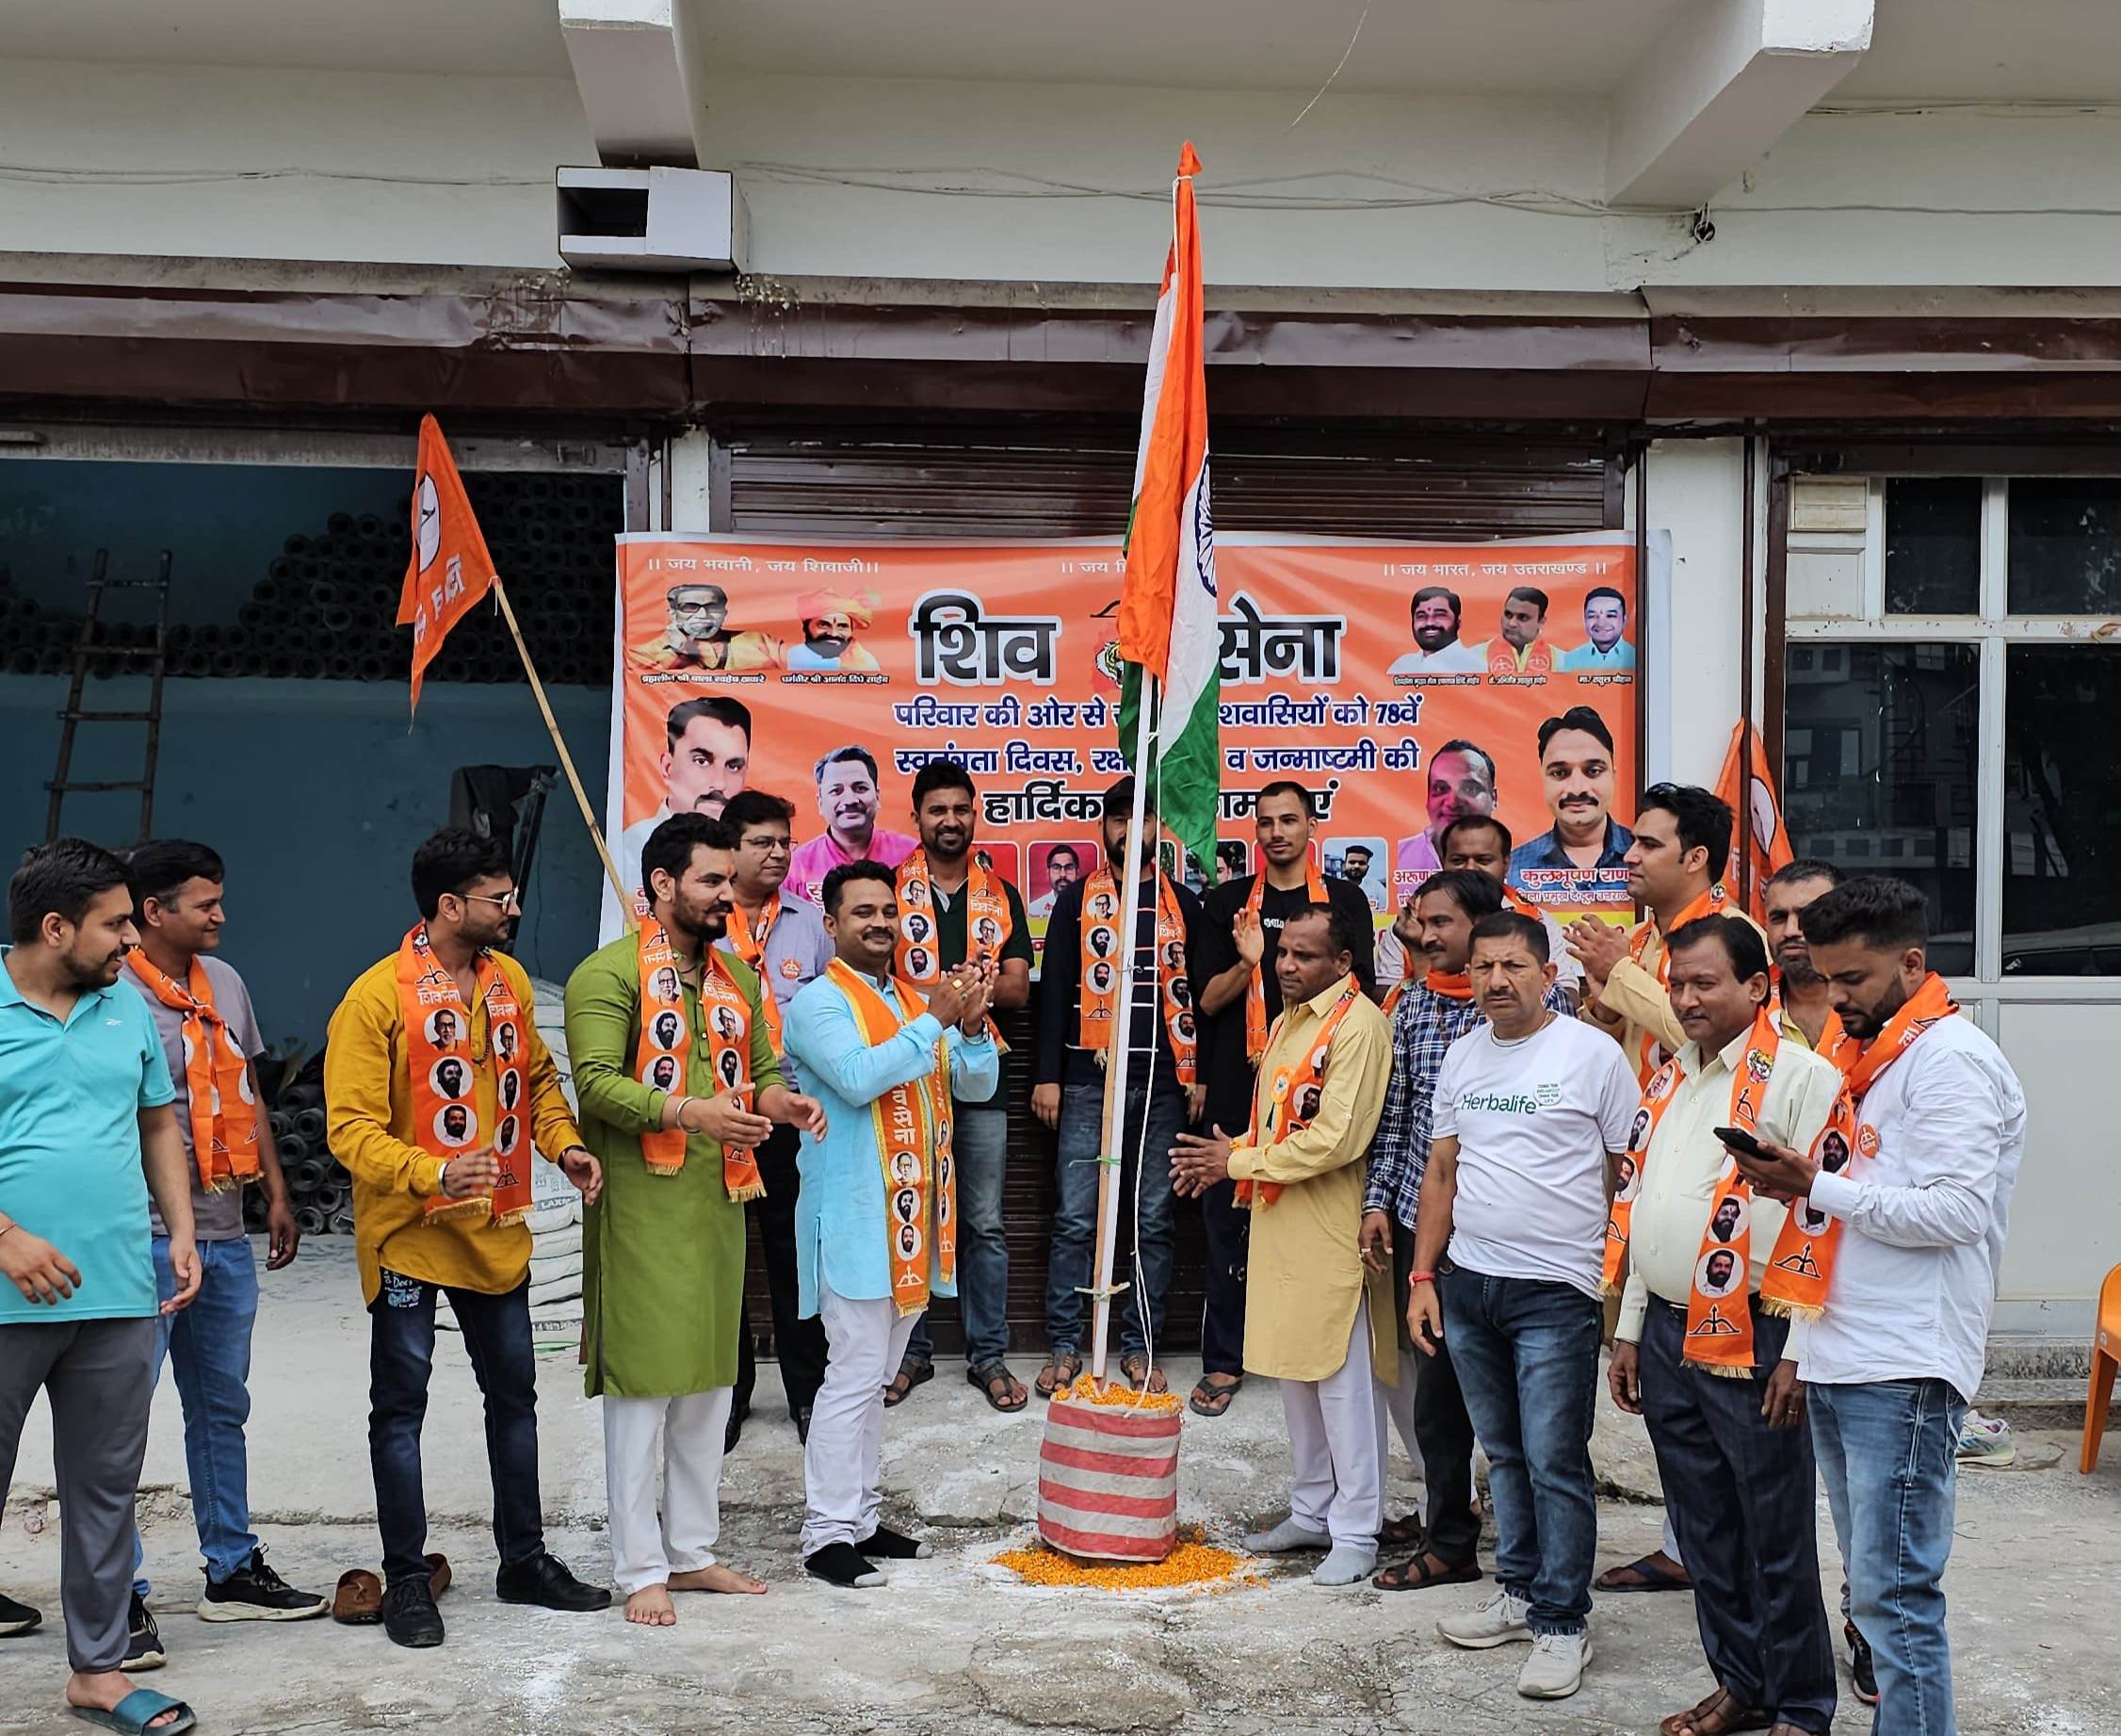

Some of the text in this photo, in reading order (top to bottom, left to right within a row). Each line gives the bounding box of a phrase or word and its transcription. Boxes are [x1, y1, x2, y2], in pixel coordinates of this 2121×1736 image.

[668, 558, 697, 570] जय
[704, 556, 759, 573] भवानी,
[768, 560, 796, 573] जय
[1080, 561, 1109, 573] जय
[1401, 563, 1427, 576] जय
[1433, 563, 1476, 577] भारत,
[1481, 563, 1507, 576] जय
[1514, 562, 1587, 576] उत्तराखण्ड
[910, 592, 1344, 682] शिव सेना
[894, 695, 978, 727] परिवार
[984, 695, 1020, 727] की
[1028, 695, 1077, 727] ओर
[1082, 695, 1106, 727] से
[1218, 693, 1330, 725] शवासियों
[1333, 693, 1368, 725] को
[1006, 741, 1084, 773] दिवस,
[1225, 748, 1247, 770] व
[1383, 738, 1420, 770] की
[982, 780, 1106, 824] हार्दिक
[1520, 868, 1629, 888] कुलभूषण राण
[1461, 1094, 1537, 1115] Herbalife
